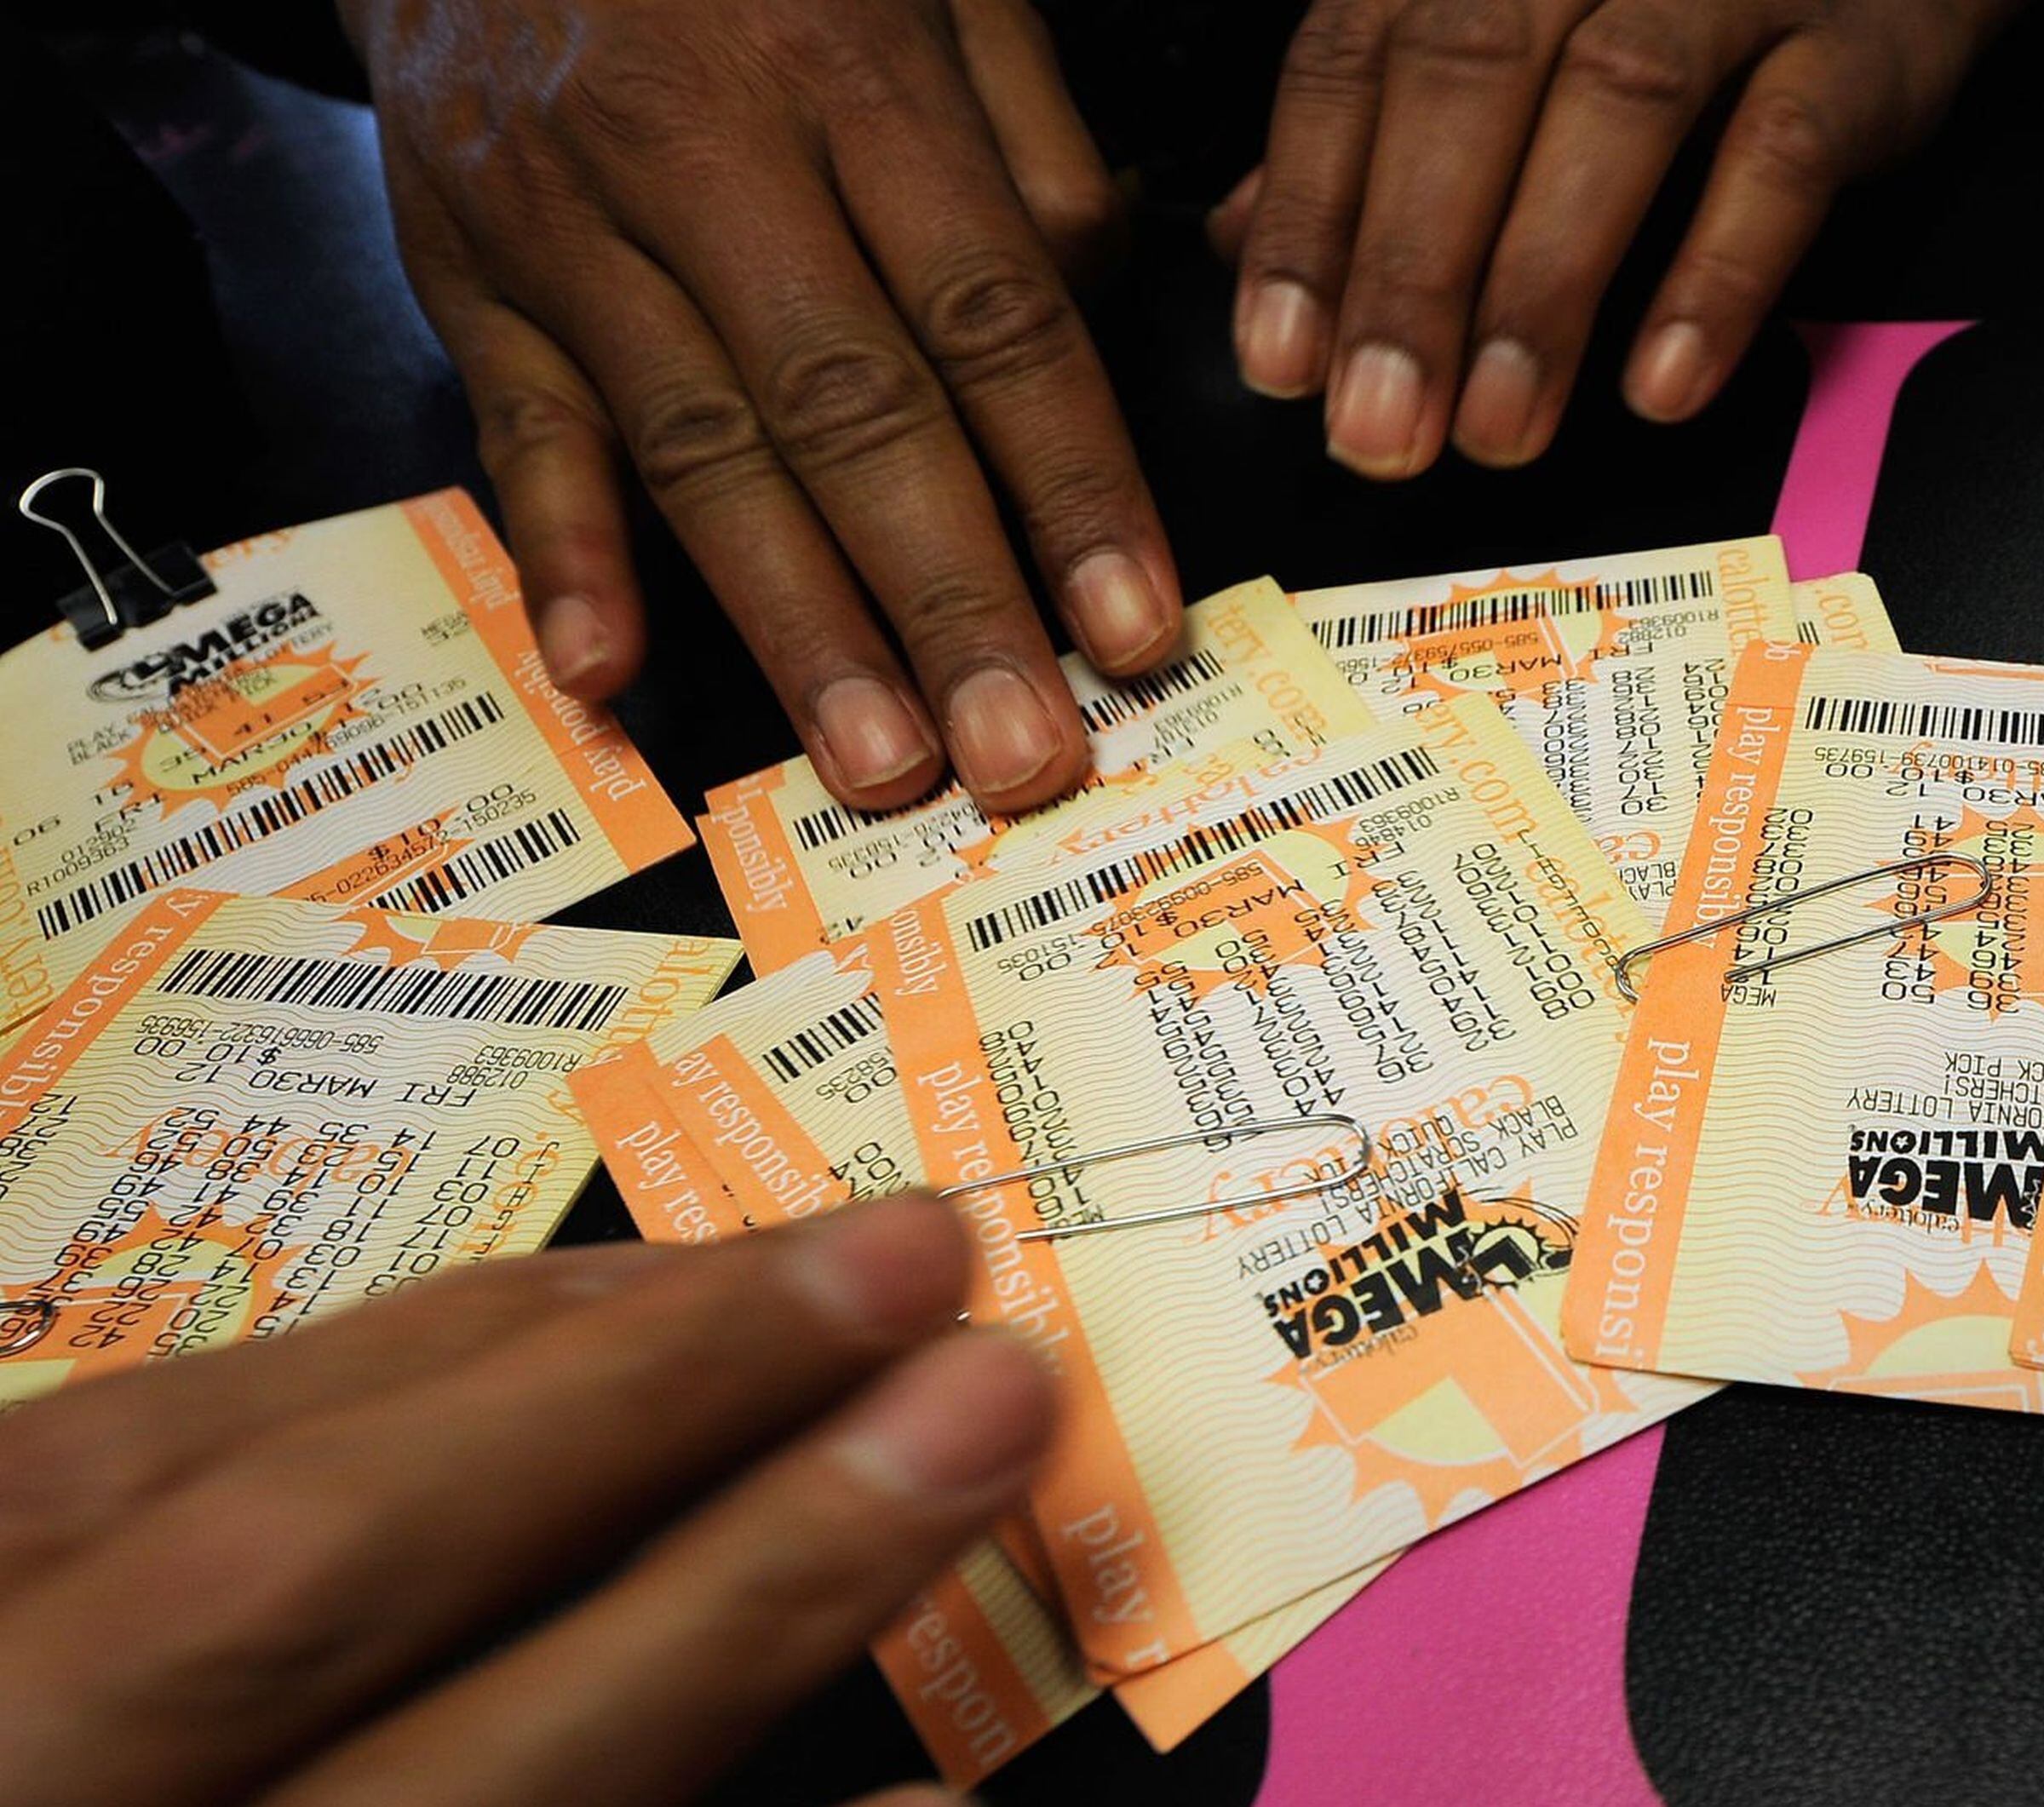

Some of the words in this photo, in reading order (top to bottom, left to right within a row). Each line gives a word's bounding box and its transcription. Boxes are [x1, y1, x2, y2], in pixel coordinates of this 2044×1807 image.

[169, 594, 317, 678] MEGA
[1593, 637, 1653, 661] FRI
[1449, 653, 1562, 682] MAR30
[1611, 666, 1656, 686] 28
[1381, 676, 1418, 694] 12
[1612, 680, 1656, 698] 36
[1726, 705, 1781, 766] play
[95, 792, 161, 834] FRI
[192, 722, 317, 785] MAR30
[343, 688, 381, 714] 12
[584, 741, 648, 802] play
[1825, 759, 1975, 785] $10.00
[1886, 782, 1928, 797] 12
[368, 783, 520, 861] $10.00
[1358, 787, 1461, 834] R1009363
[1763, 807, 1814, 825] 02
[1914, 814, 1955, 831] 41
[1354, 812, 1433, 852] 014846
[1760, 823, 1809, 841] 33
[1903, 829, 1954, 848] 49
[1985, 820, 2035, 840] 25
[711, 804, 796, 915] ponsibly
[1331, 836, 1405, 880] FRI
[1692, 772, 1757, 950] responsiby
[1983, 837, 2033, 857] 33
[1173, 878, 1306, 938] MAR30
[1486, 904, 1539, 933] 03
[1018, 906, 1179, 982] $10.00
[1410, 935, 1455, 962] 14
[1503, 922, 1547, 948] 11
[1091, 943, 1141, 970] 12
[1418, 951, 1468, 980] 15
[1507, 939, 1555, 967] 12
[1328, 961, 1384, 994] 26
[1429, 970, 1478, 995] 40
[1884, 960, 1937, 982] 43
[1968, 969, 2023, 993] 39
[1337, 982, 1387, 1011] 19
[1720, 983, 1777, 1007] MEGA
[1881, 981, 1936, 1004] 50
[1966, 990, 2022, 1014] 36
[1252, 993, 1302, 1027] 37
[1346, 1000, 1398, 1028] 46
[1254, 1009, 1312, 1043] 22
[133, 1035, 289, 1067] $10.00
[474, 1044, 583, 1073] R1009363
[1162, 1030, 1215, 1059] 49
[1263, 1027, 1321, 1061] 53
[174, 1062, 222, 1084] 12
[1168, 1043, 1228, 1077] 52
[1944, 1052, 2002, 1078] PICK
[248, 1069, 378, 1099] MAR30
[445, 1064, 531, 1090] 012988
[1178, 1061, 1237, 1095] 55
[1633, 1037, 1701, 1133] play
[1942, 1074, 2042, 1105] TCHERS!
[28, 1092, 78, 1116] 12
[393, 1081, 478, 1108] FRI
[916, 1061, 983, 1134] play
[1001, 1090, 1060, 1125] 09
[1846, 1087, 1954, 1120] LOTTERY
[8, 1115, 68, 1139] 27
[164, 1106, 221, 1131] 52
[240, 1114, 292, 1138] 44
[1008, 1106, 1068, 1143] 29
[1486, 1094, 1566, 1140] BLACK
[1968, 1099, 2042, 1130] ORNIA
[146, 1127, 204, 1154] 52
[313, 1121, 370, 1145] 35
[391, 1127, 437, 1151] 14
[462, 1135, 520, 1158] 07
[1376, 1115, 1455, 1161] QUICK
[1518, 1116, 1579, 1158] PLAY
[1851, 1127, 2044, 1162] MILLIONS
[129, 1150, 183, 1175] 46
[221, 1135, 278, 1162] 50
[297, 1143, 355, 1167] 23
[372, 1150, 422, 1174] 15
[698, 1078, 843, 1221] responsib
[827, 1141, 883, 1181] 04
[204, 1159, 261, 1184] 38
[281, 1166, 329, 1190] 14
[455, 1157, 497, 1181] 11
[616, 1120, 687, 1191] play
[663, 1190, 720, 1246] res
[1313, 1131, 1480, 1214] SCRATCHERS!
[356, 1173, 405, 1196] 10
[433, 1179, 489, 1203] 03
[1354, 1146, 1507, 1225] CALIFORNIA
[1848, 1155, 2044, 1227] MEGA
[1238, 1213, 1348, 1279] LOTTERY
[1259, 1188, 1467, 1319] MILLIONS
[1272, 1226, 1480, 1360] MEGA
[1061, 1504, 1153, 1626] play
